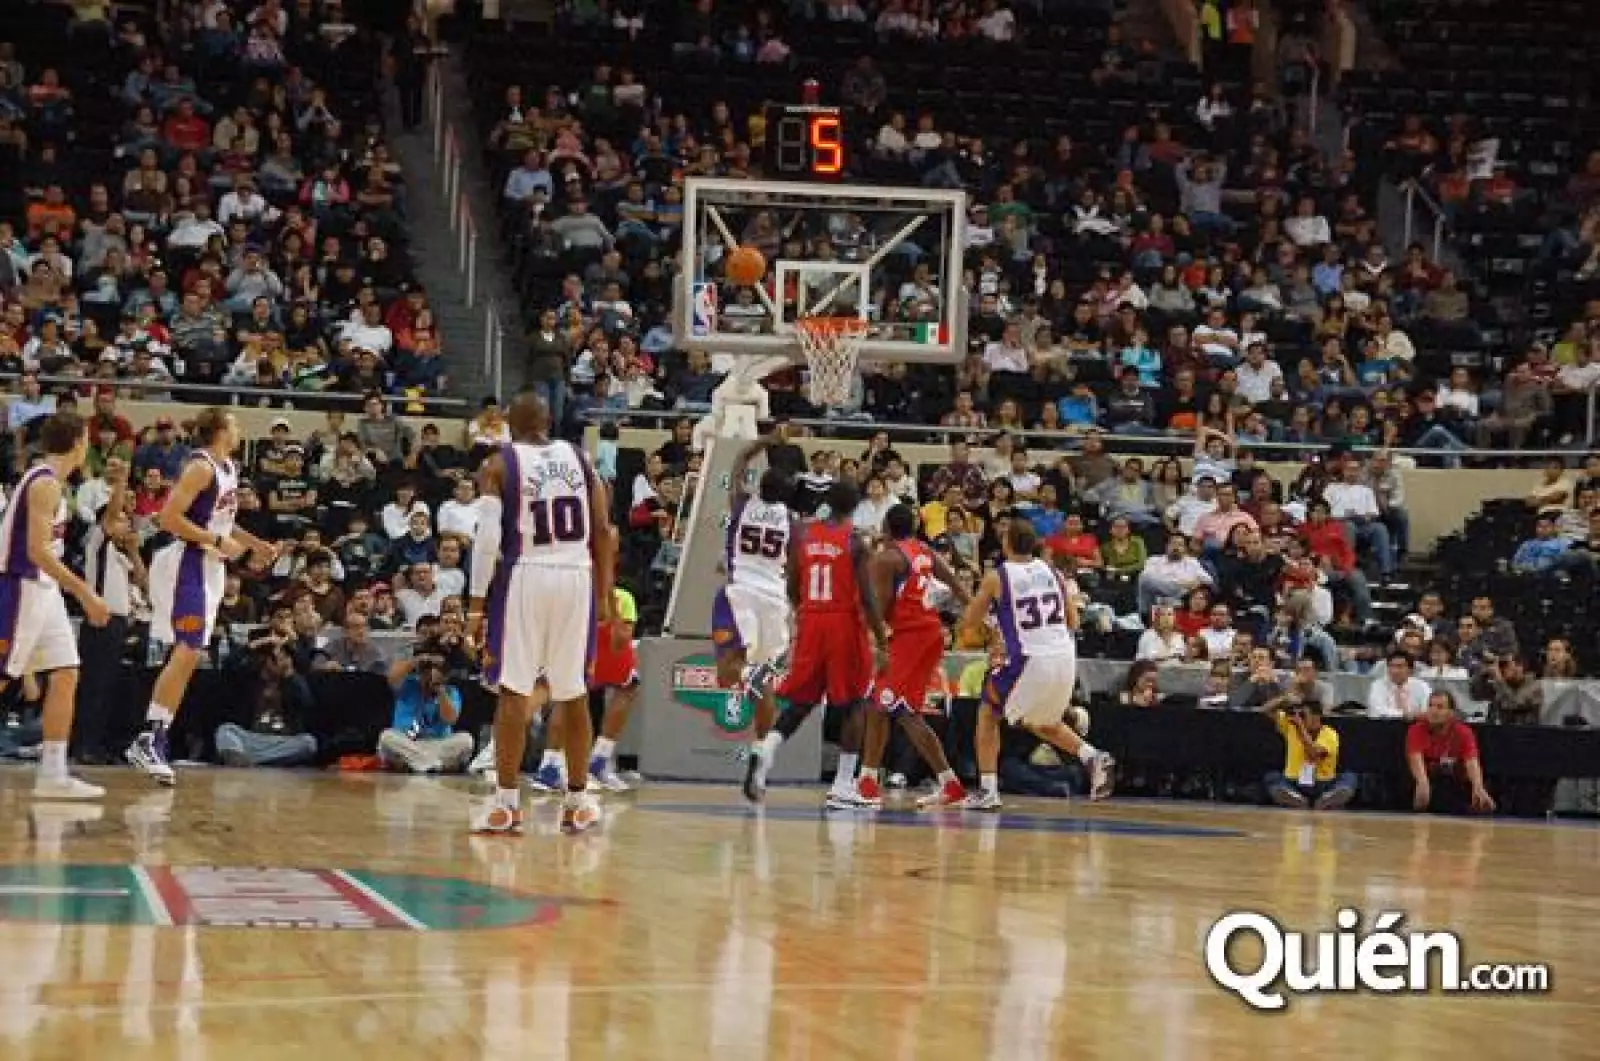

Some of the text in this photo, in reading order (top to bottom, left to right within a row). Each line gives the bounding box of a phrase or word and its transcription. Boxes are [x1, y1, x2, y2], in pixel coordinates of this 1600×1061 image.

[811, 117, 843, 173] 5
[528, 496, 585, 546] 10
[740, 524, 786, 558] 55
[809, 564, 833, 601] 11
[1015, 593, 1064, 630] 32
